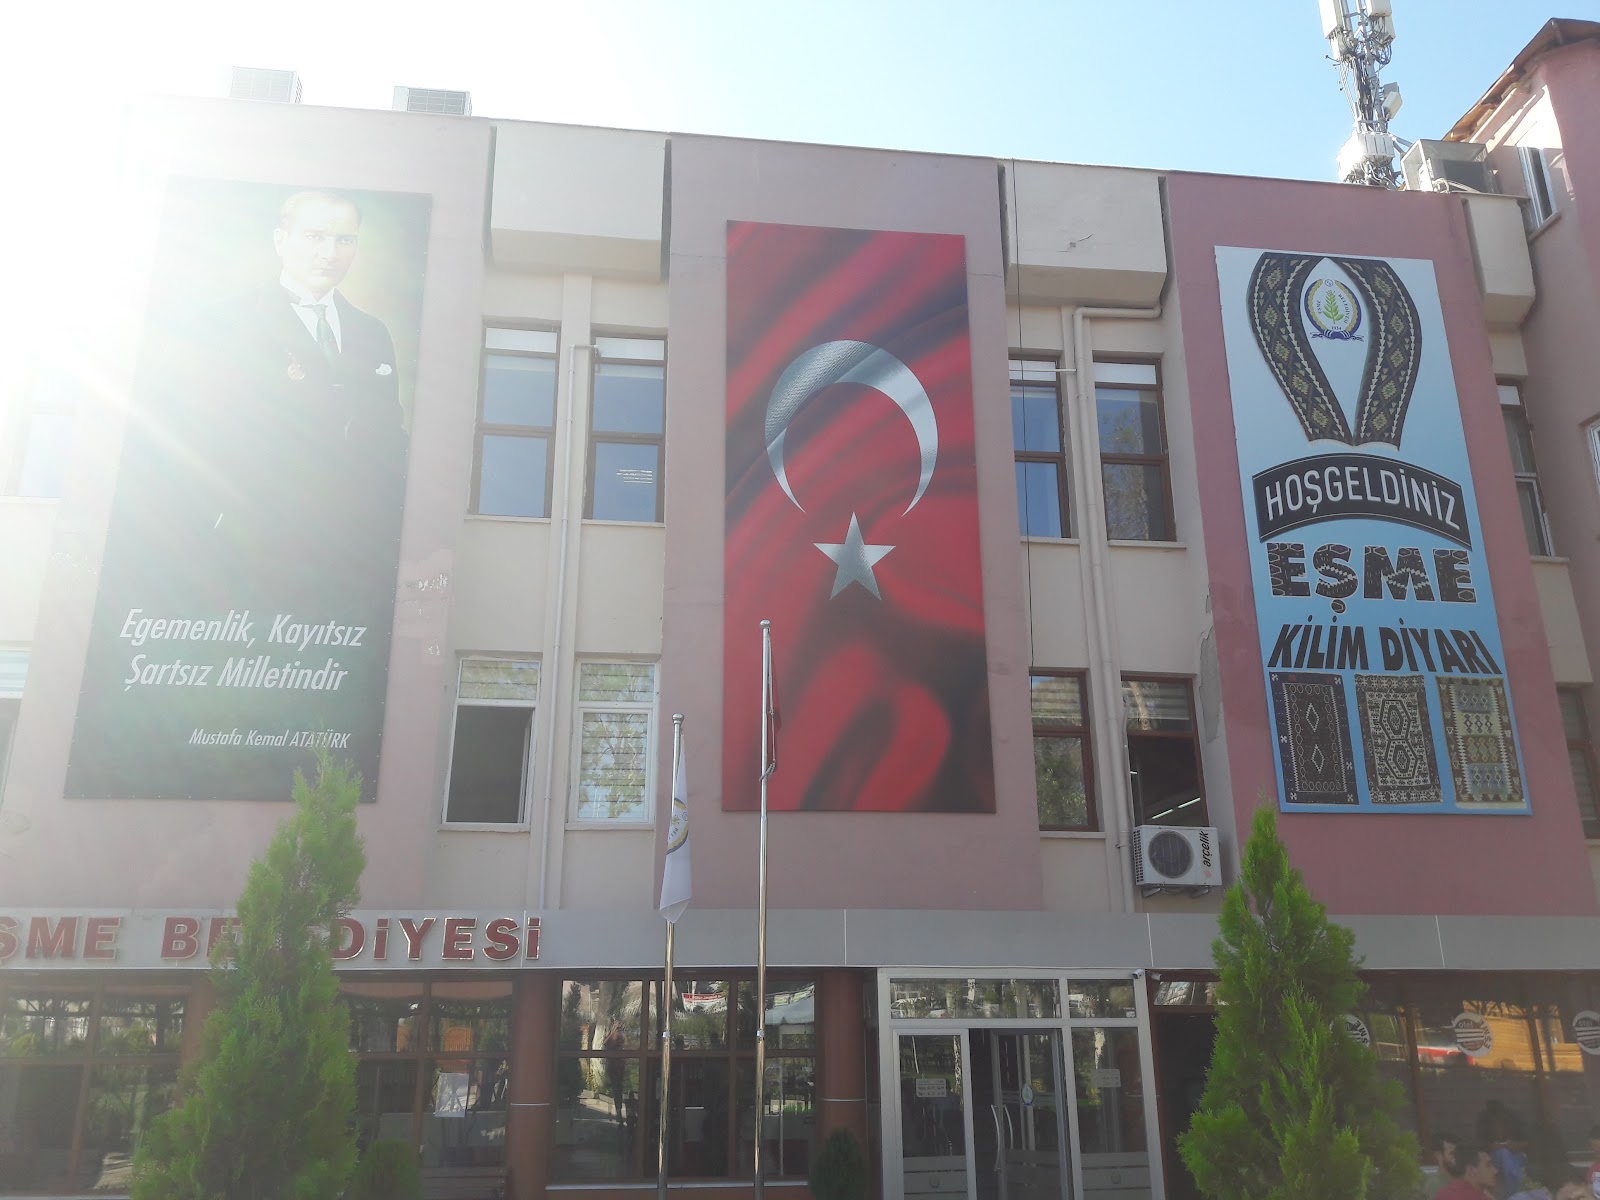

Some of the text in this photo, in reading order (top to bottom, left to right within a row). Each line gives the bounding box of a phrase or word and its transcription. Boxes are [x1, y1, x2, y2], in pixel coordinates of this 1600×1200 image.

[1265, 466, 1461, 530] HOŞGELDİNİZ
[1266, 542, 1477, 614] EŞME
[119, 608, 367, 651] Egemenlik, Kayıtsız
[1267, 614, 1502, 675] KİLİM DİYARI
[124, 653, 348, 692] Şartsız Milletindir
[189, 728, 351, 749] Mustafa Kemal ATATÜRK
[1199, 830, 1212, 867] arçelik
[160, 916, 542, 961] BEDİYESİ
